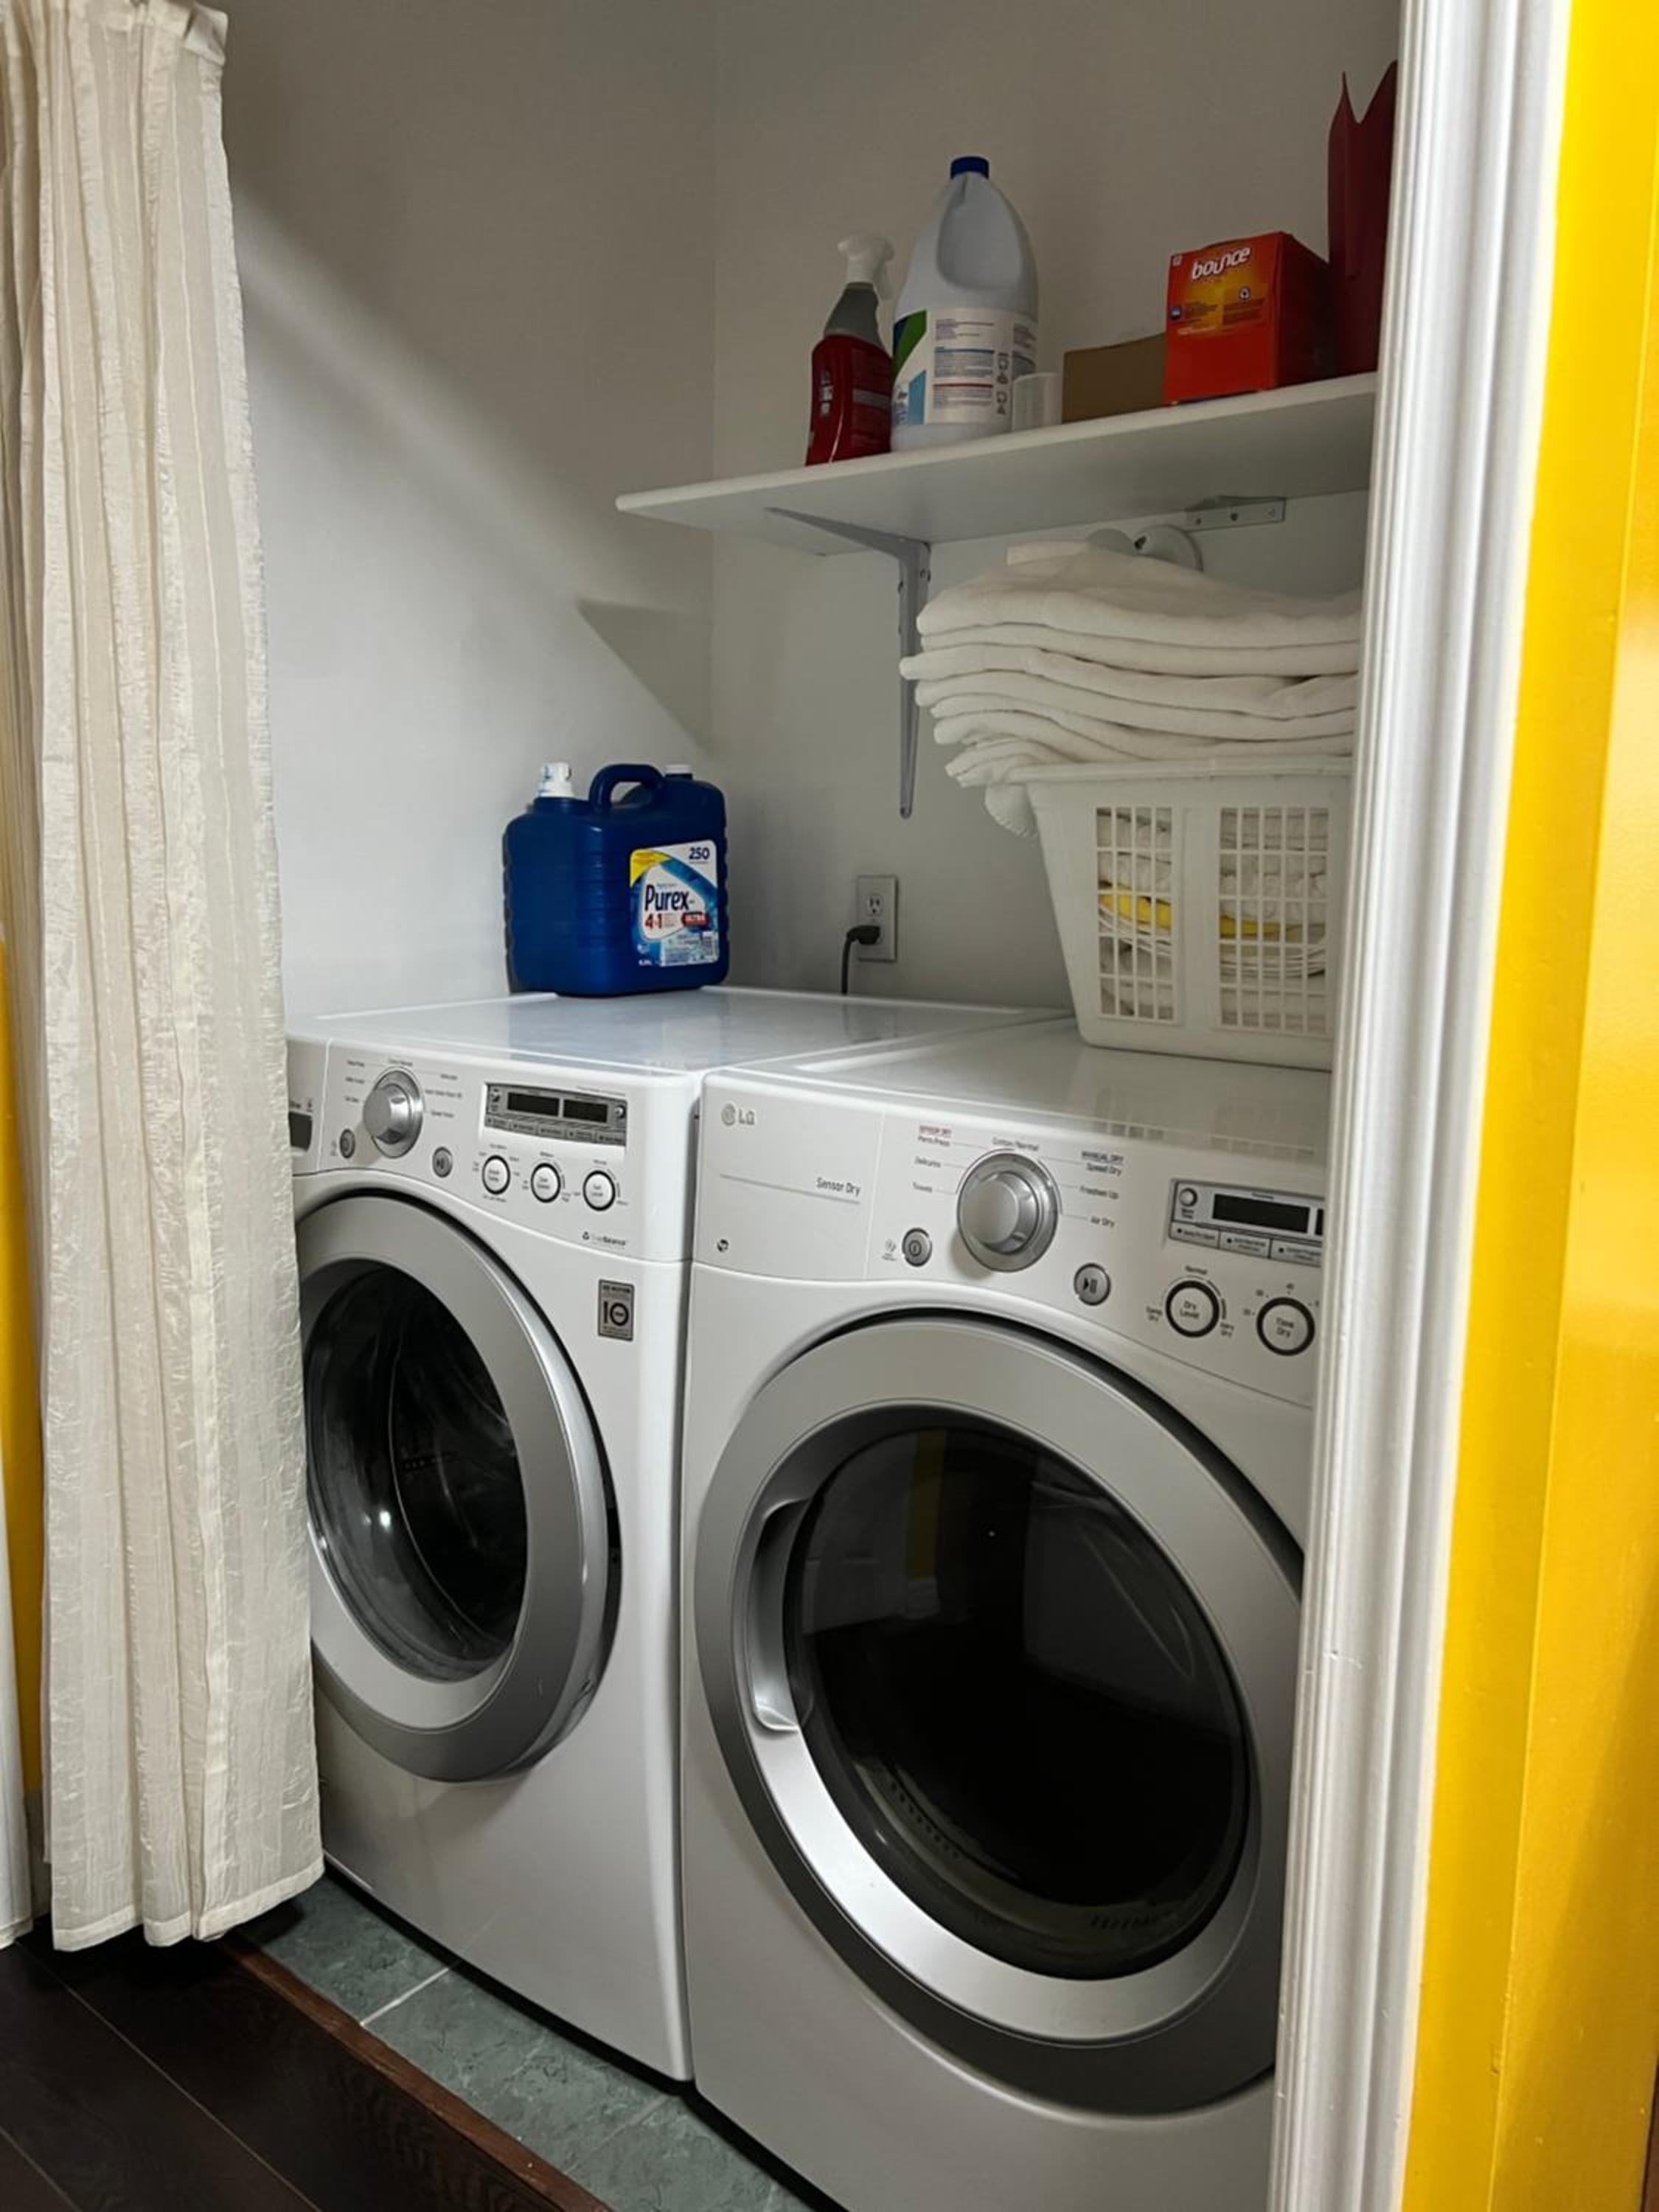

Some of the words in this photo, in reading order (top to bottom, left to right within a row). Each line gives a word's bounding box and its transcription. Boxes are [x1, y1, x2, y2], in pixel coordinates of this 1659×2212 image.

[1192, 247, 1251, 279] bounce
[689, 846, 710, 860] 250
[644, 884, 690, 911] Purex
[738, 1108, 755, 1126] LG
[816, 1177, 845, 1192] Sensor
[846, 1182, 860, 1197] Dry
[1183, 1300, 1197, 1310] Dry
[1180, 1308, 1200, 1320] Level
[1276, 1317, 1295, 1329] Time
[1276, 1327, 1291, 1338] Dry
